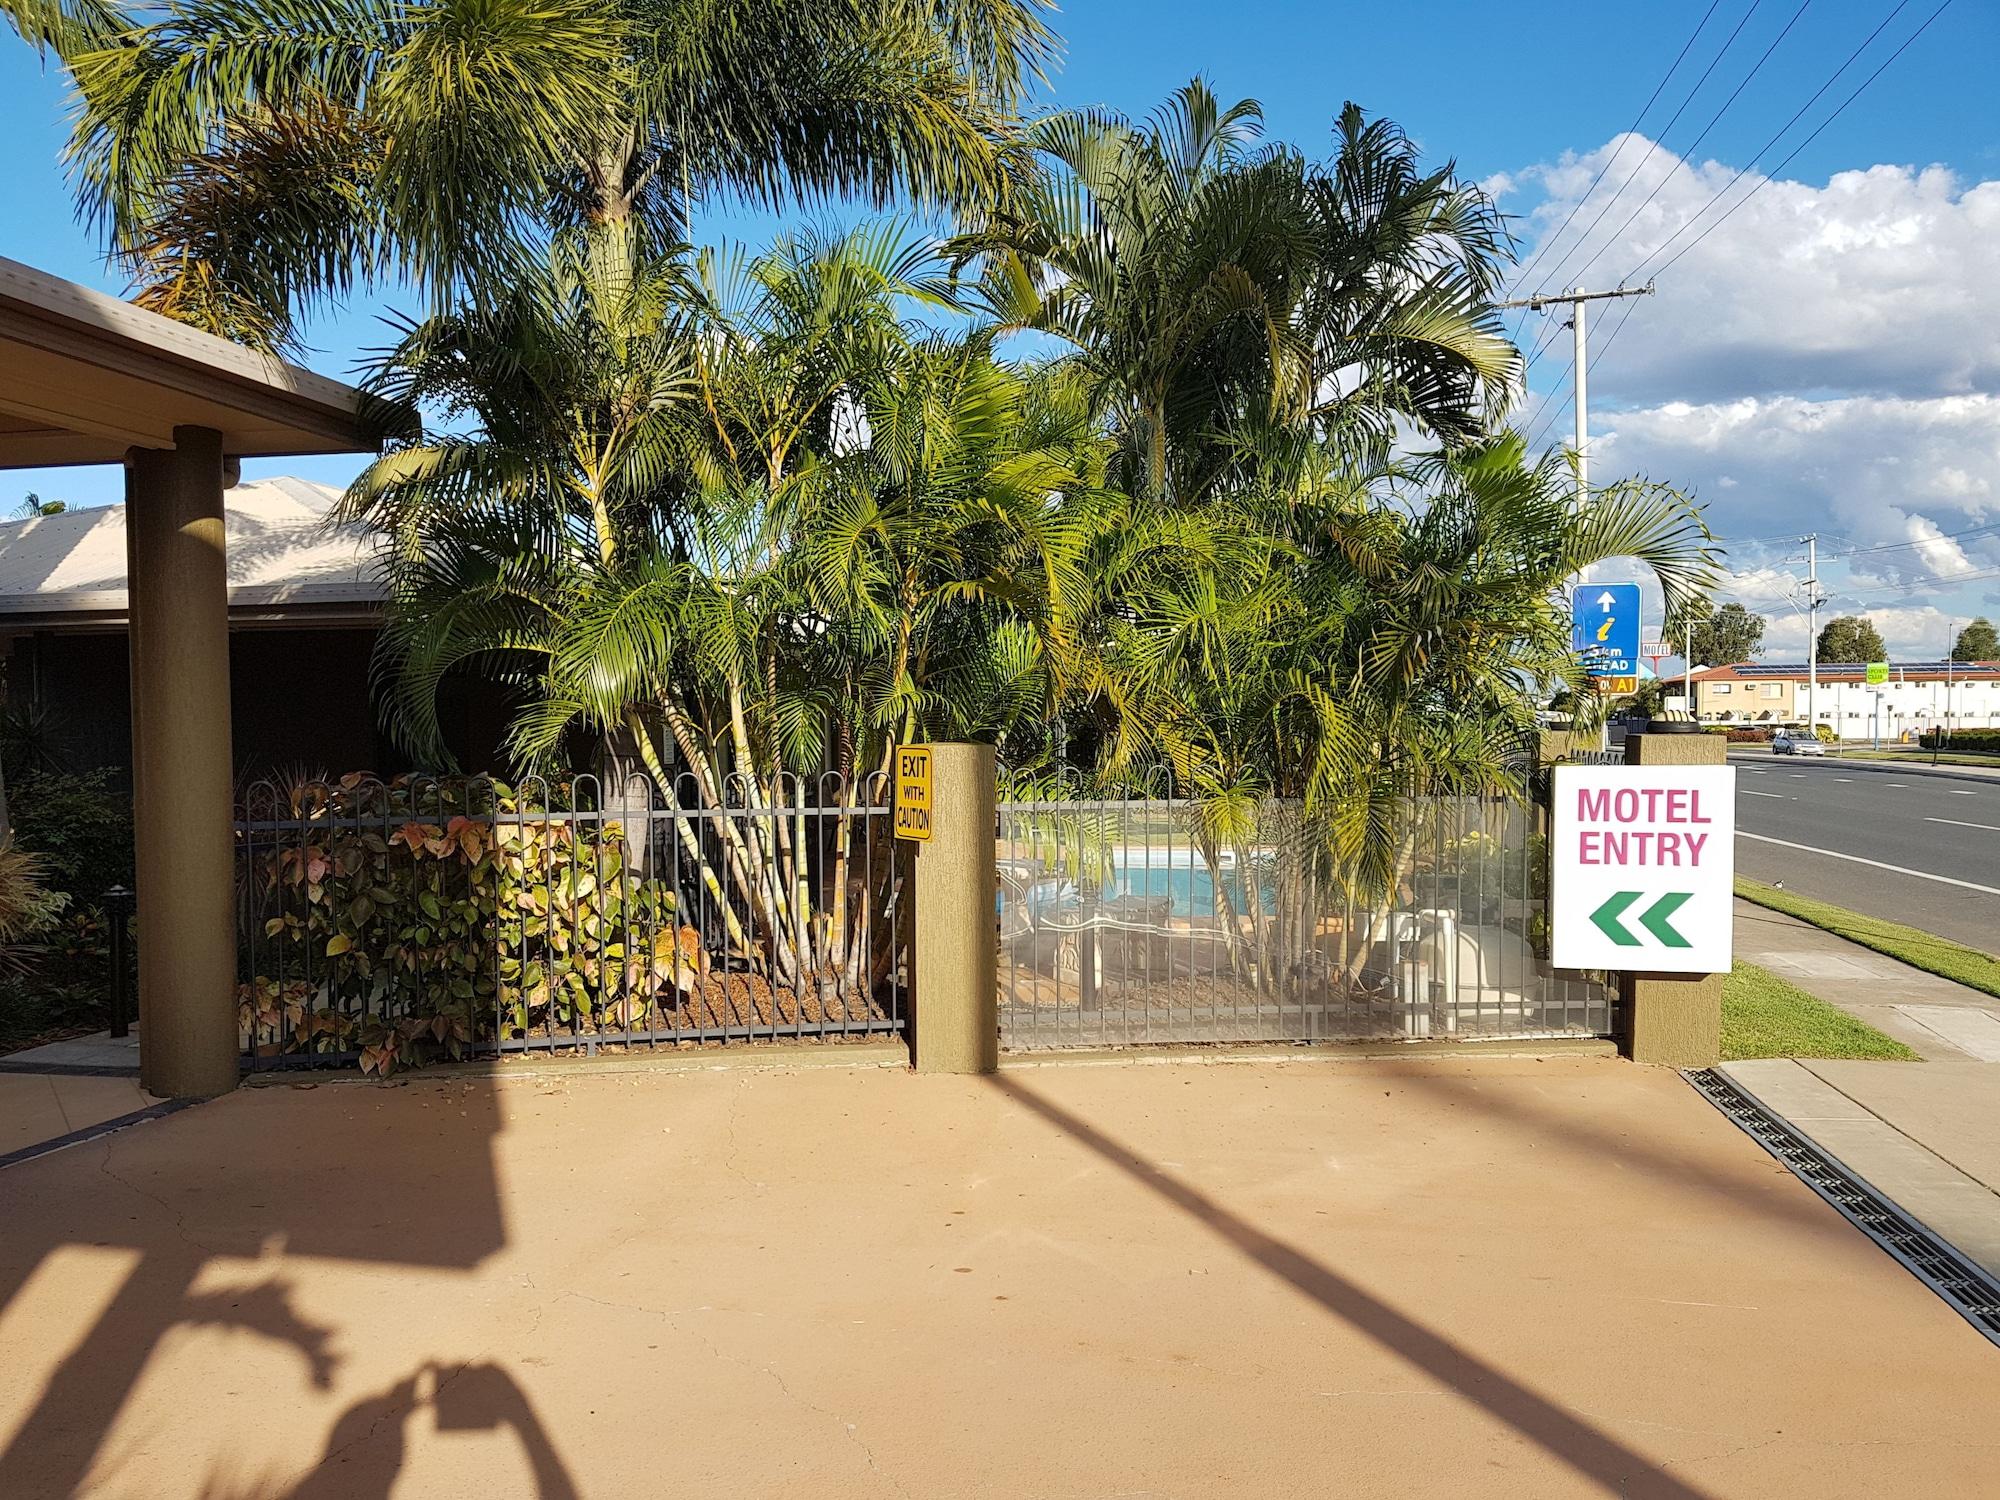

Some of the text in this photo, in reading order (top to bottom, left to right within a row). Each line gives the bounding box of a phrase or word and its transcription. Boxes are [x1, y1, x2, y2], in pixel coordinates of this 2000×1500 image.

[1643, 645, 1669, 655] MOTEL
[1616, 678, 1634, 692] A1
[903, 756, 927, 778] EXIT
[903, 785, 925, 801] WITH
[1577, 788, 1712, 823] MOTEL
[898, 806, 930, 830] CAUTION
[1579, 831, 1709, 866] ENTRY
